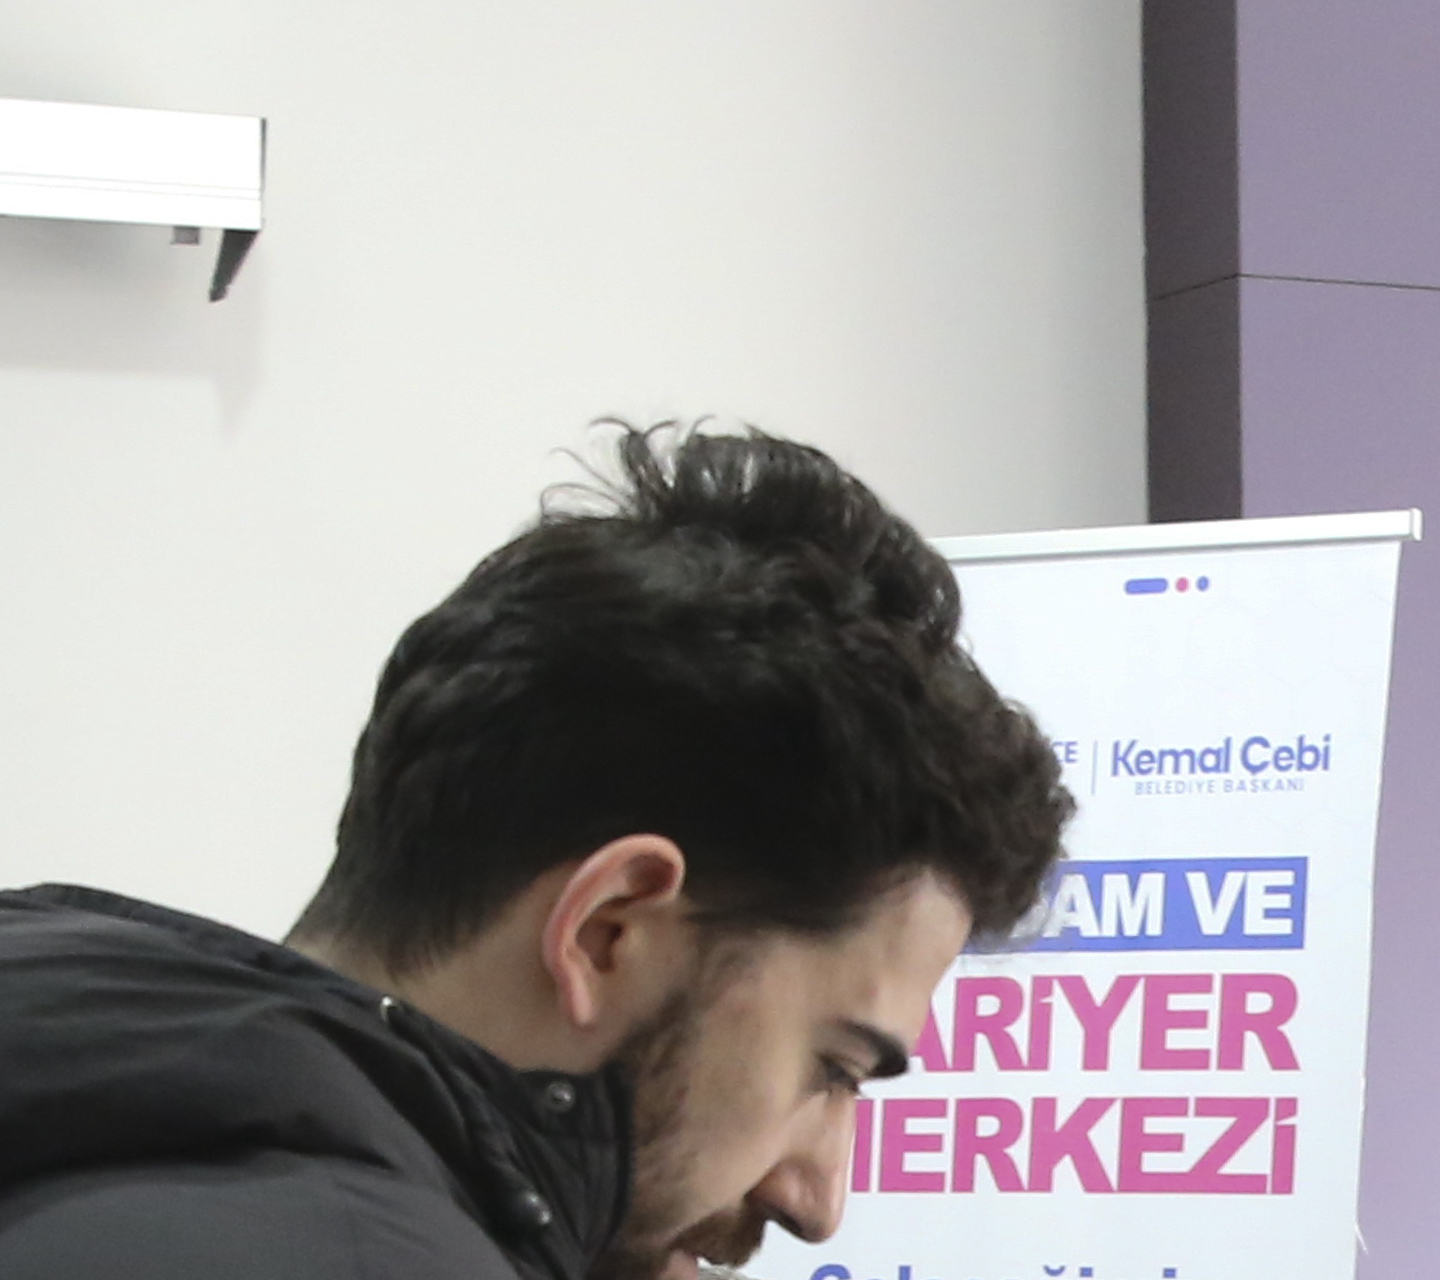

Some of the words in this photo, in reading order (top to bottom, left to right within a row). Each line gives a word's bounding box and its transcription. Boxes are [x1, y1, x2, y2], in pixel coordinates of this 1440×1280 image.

[1111, 736, 1232, 777] Kemal
[1240, 733, 1332, 775] Çebi
[1184, 869, 1296, 936] VE
[850, 1096, 1298, 1195] ERKEZİ
